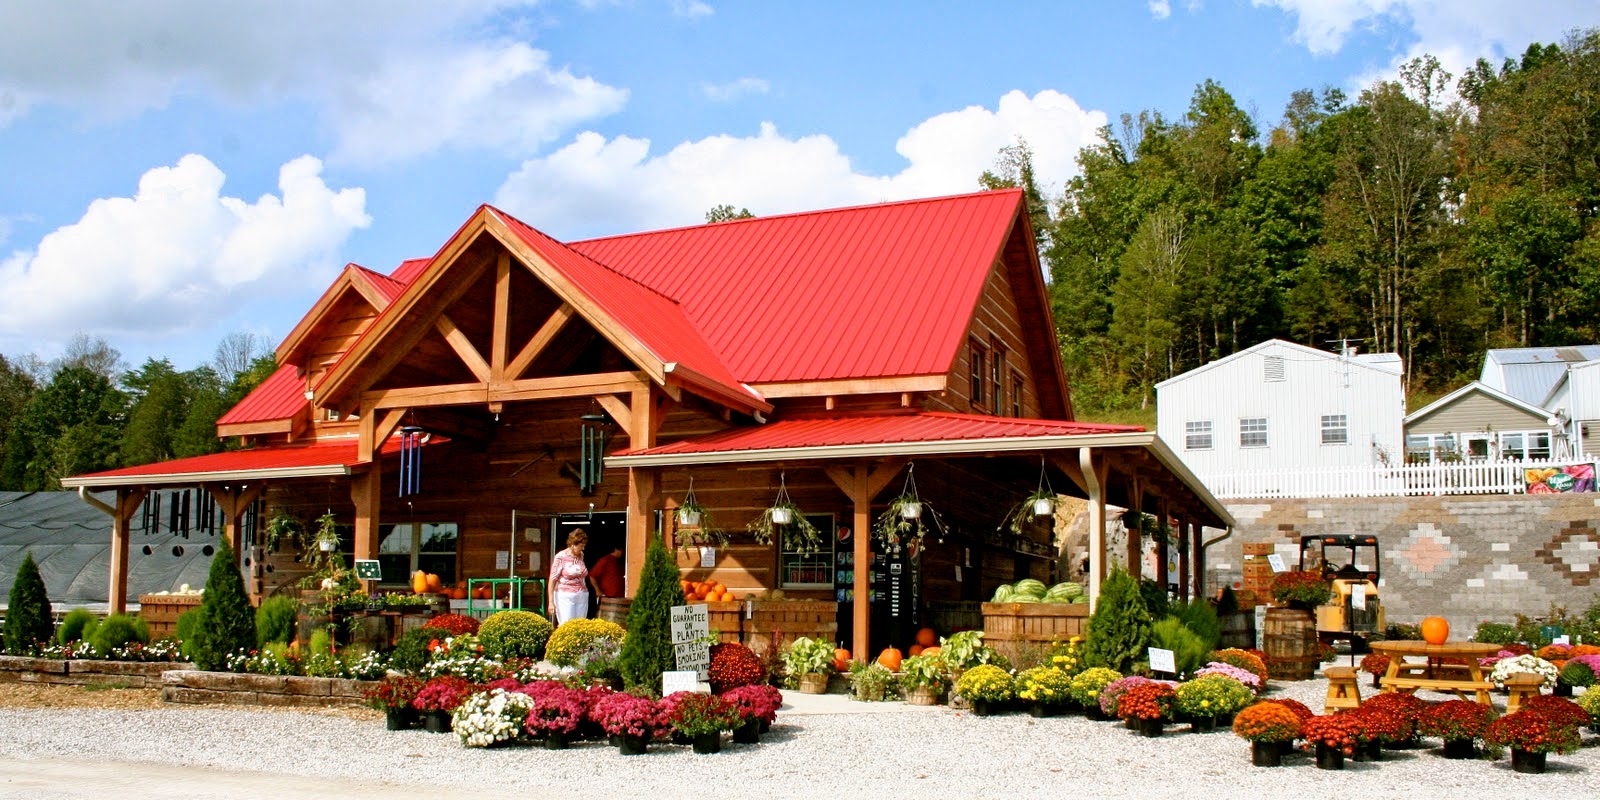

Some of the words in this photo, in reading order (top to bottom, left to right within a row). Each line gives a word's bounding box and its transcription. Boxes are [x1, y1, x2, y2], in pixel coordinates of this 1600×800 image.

[685, 606, 693, 614] NO
[673, 614, 705, 622] GUARANTEE
[685, 622, 693, 630] ON
[677, 630, 704, 641] PLANTS
[677, 644, 685, 654] NO
[688, 642, 703, 652] PETS
[678, 651, 706, 665] SMOKING
[665, 672, 695, 684] MUMS
